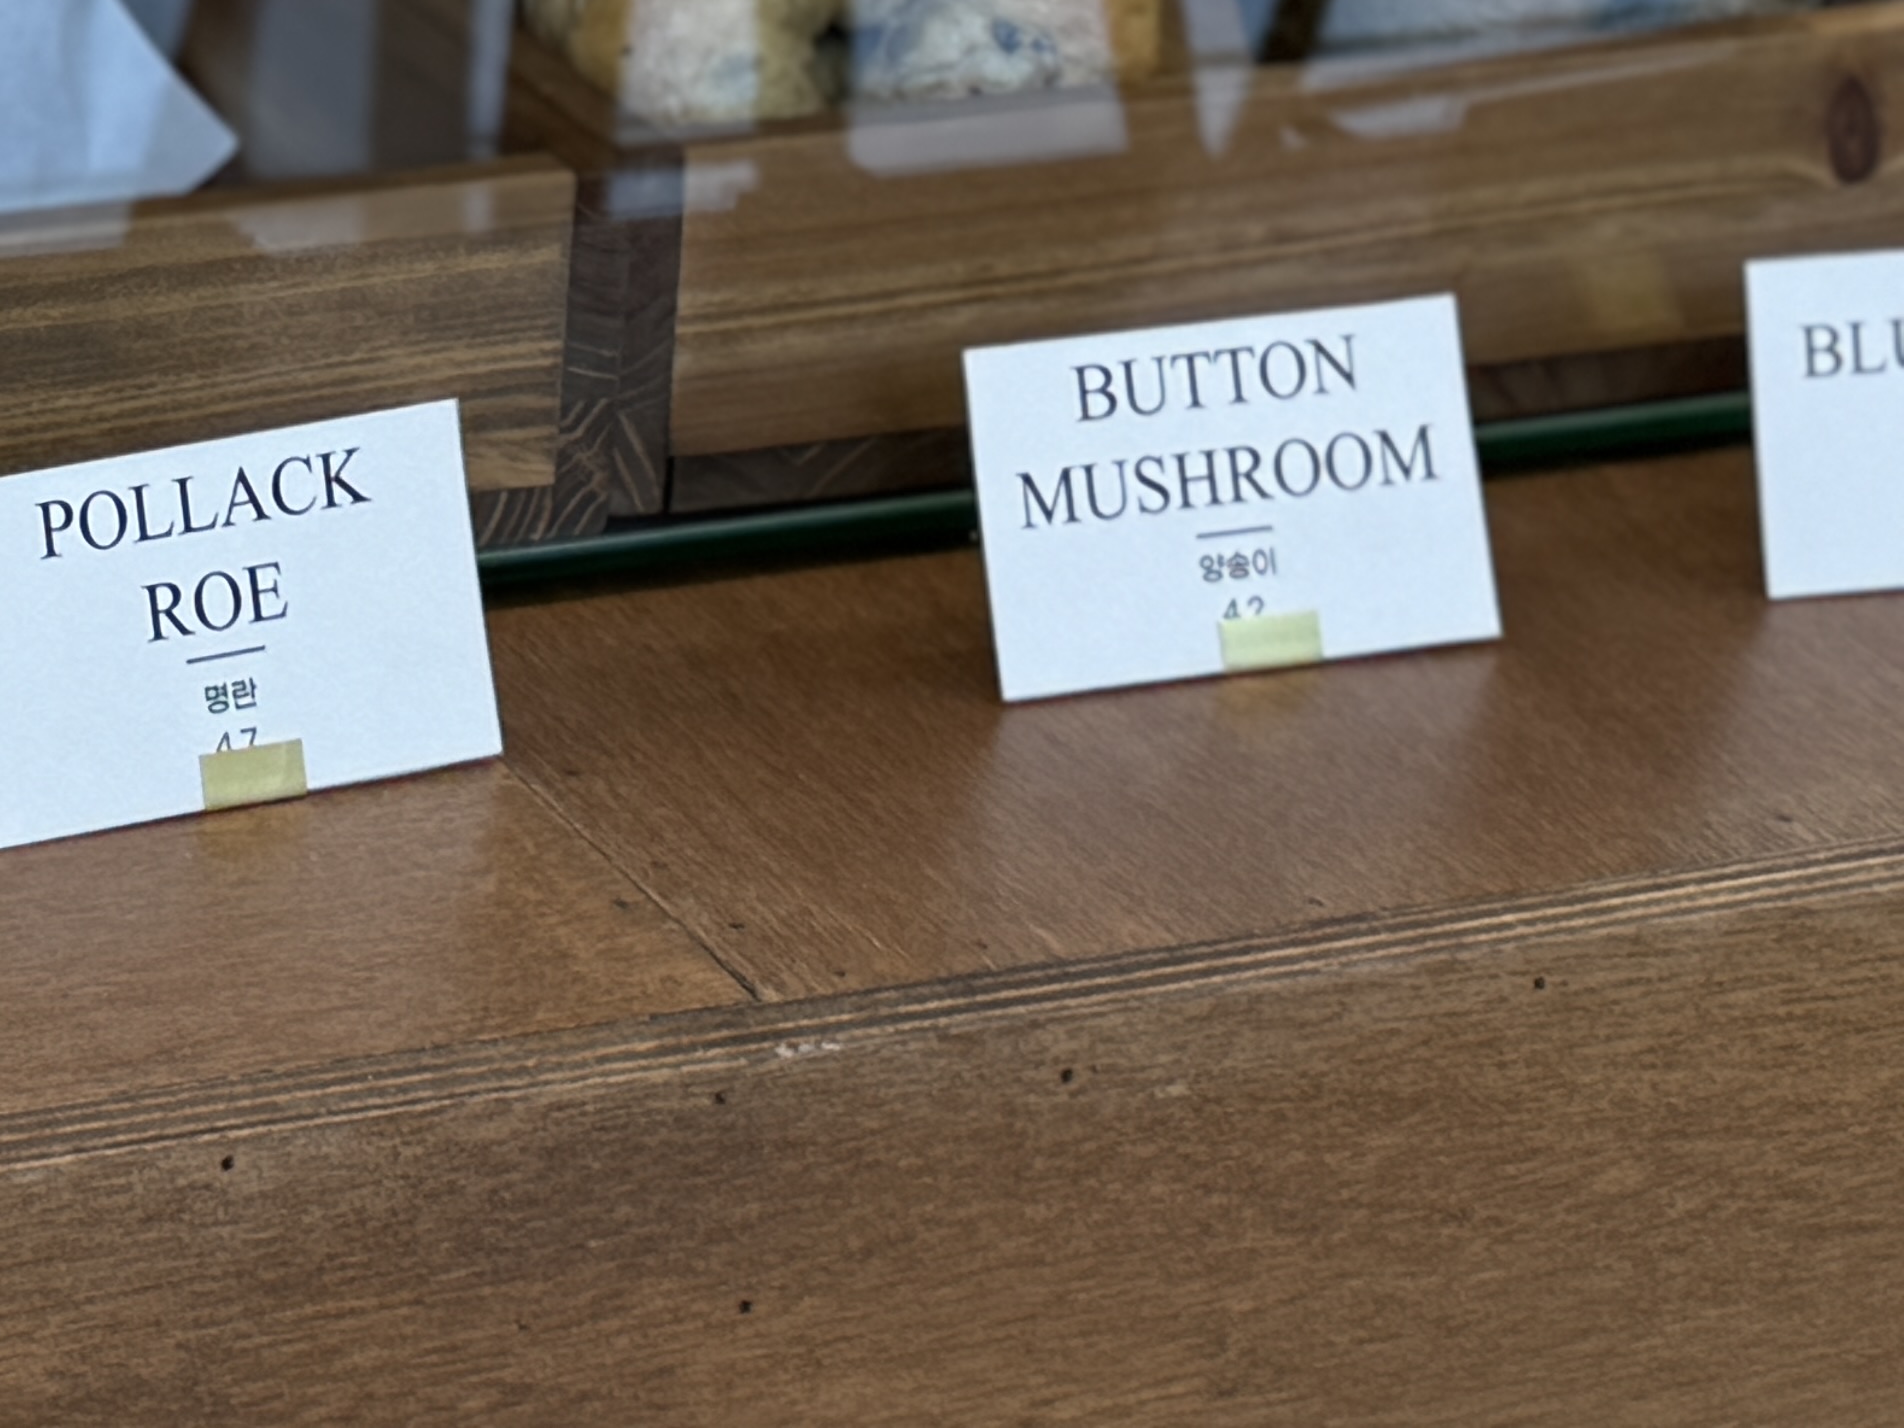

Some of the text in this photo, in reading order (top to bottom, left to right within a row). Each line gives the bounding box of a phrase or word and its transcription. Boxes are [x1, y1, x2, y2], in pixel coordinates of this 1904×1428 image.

[1071, 334, 1358, 423] BUTTON
[34, 447, 372, 560] POLLACK
[1017, 424, 1440, 529] MUSHROOM
[1199, 547, 1277, 582] 양송이
[142, 561, 288, 642] ROE
[1223, 595, 1265, 619] 42
[204, 677, 257, 714] 명란
[215, 728, 258, 752] 47
